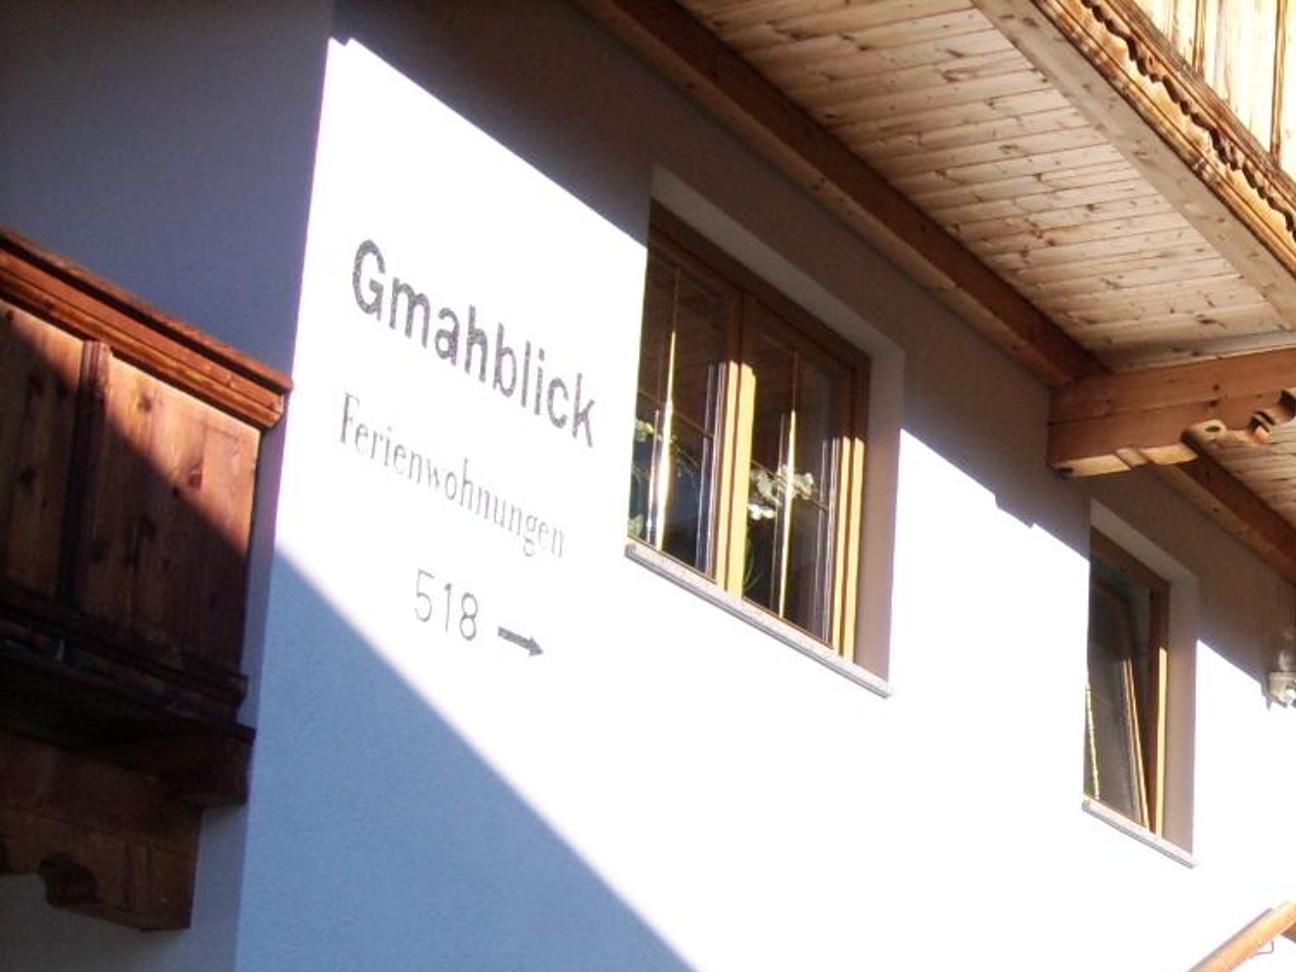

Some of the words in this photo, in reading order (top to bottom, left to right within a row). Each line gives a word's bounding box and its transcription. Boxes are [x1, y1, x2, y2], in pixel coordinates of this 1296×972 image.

[352, 239, 594, 448] Gmahblick
[340, 391, 566, 558] Ferienwohnungen
[414, 568, 479, 641] 518
